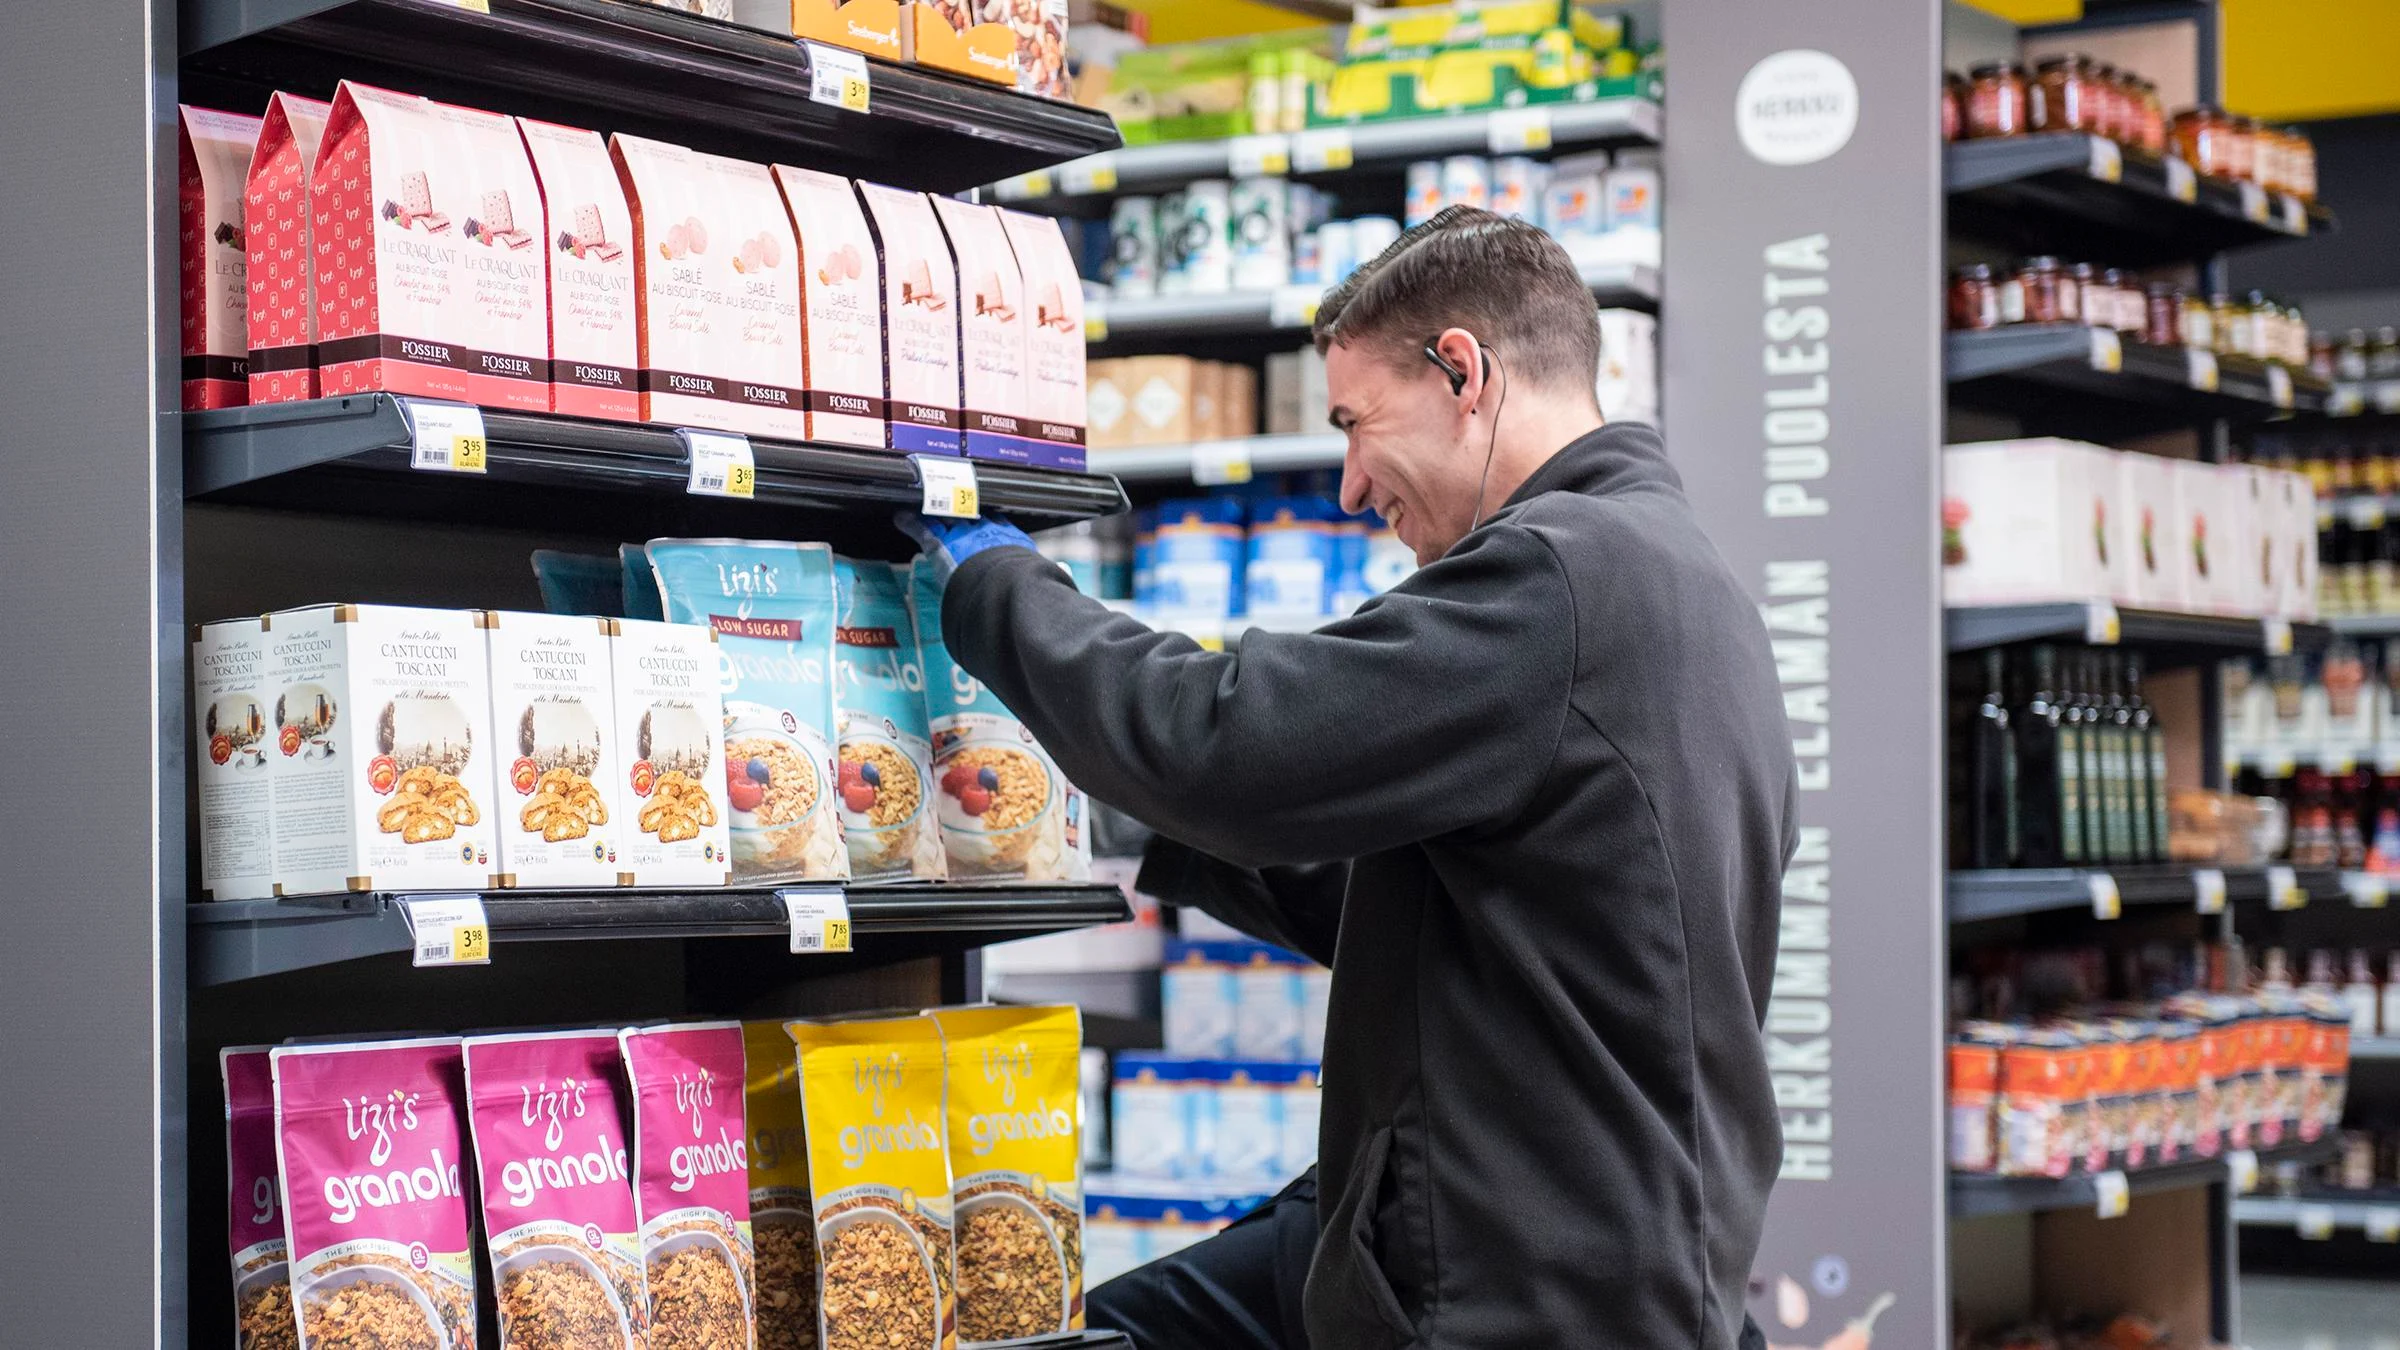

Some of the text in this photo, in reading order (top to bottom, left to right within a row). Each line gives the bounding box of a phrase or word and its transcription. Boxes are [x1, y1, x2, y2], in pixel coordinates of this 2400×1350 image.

[397, 239, 457, 264] CRAQUANT
[478, 256, 538, 280] CRAQUANT
[572, 269, 629, 292] CRAQUANT
[652, 283, 664, 295] AU
[666, 284, 699, 300] BISCUIT
[401, 340, 451, 362] FOSSIER
[481, 354, 532, 376] FOSSIER
[575, 364, 623, 385] FOSSIER
[1763, 232, 1831, 518] PUOLESTA
[669, 374, 715, 395] FOSSIER
[743, 385, 789, 404] FOSSIER
[829, 395, 871, 413] FOSSIER
[907, 405, 948, 424] FOSSIER
[716, 619, 789, 638] LOW SUGAR
[849, 630, 887, 645] SUGAR
[273, 639, 332, 656] CANTUCCINI
[381, 643, 457, 660] CANTUCCINI
[203, 650, 263, 666] CANTUCCINI
[283, 653, 323, 667] TOSCANI
[520, 649, 587, 665] CANTUCCINI
[639, 656, 699, 673] CANTUCCINI
[213, 663, 253, 677] TOSCANI
[395, 662, 446, 677] TOSCANI
[533, 666, 577, 681] TOSCANI
[650, 673, 691, 688] TOSCANI
[968, 1097, 1074, 1156] granola
[838, 1108, 941, 1169] granola
[669, 1127, 748, 1193] granola
[323, 1148, 461, 1225] granola
[255, 1245, 270, 1254] THE
[324, 1247, 344, 1260] THE
[346, 1242, 369, 1253] HIGH
